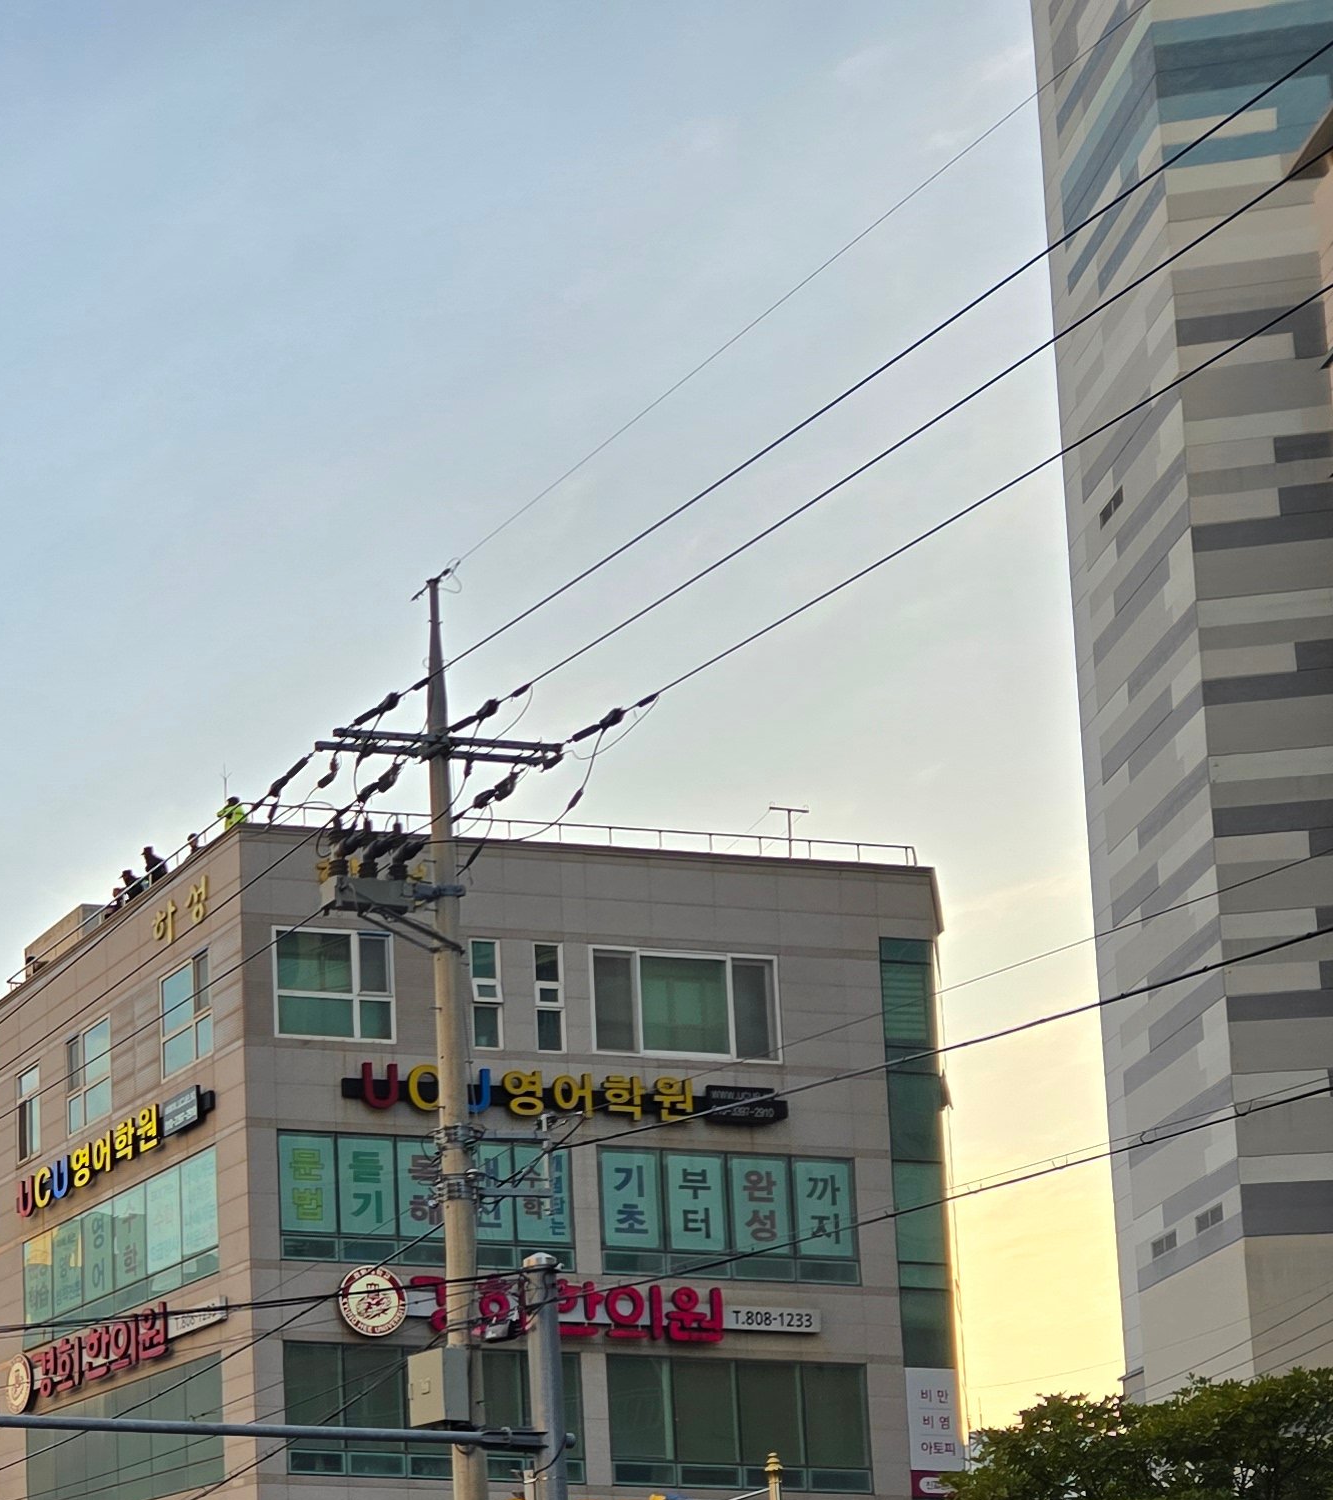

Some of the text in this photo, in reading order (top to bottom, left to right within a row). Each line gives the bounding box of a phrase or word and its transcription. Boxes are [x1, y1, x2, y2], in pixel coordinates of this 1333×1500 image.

[17, 1104, 160, 1217] UCU영어학원
[32, 1301, 167, 1397] 경희한의원
[921, 1389, 949, 1404] 비만
[923, 1416, 950, 1430] 비염
[921, 1442, 956, 1456] 아토피
